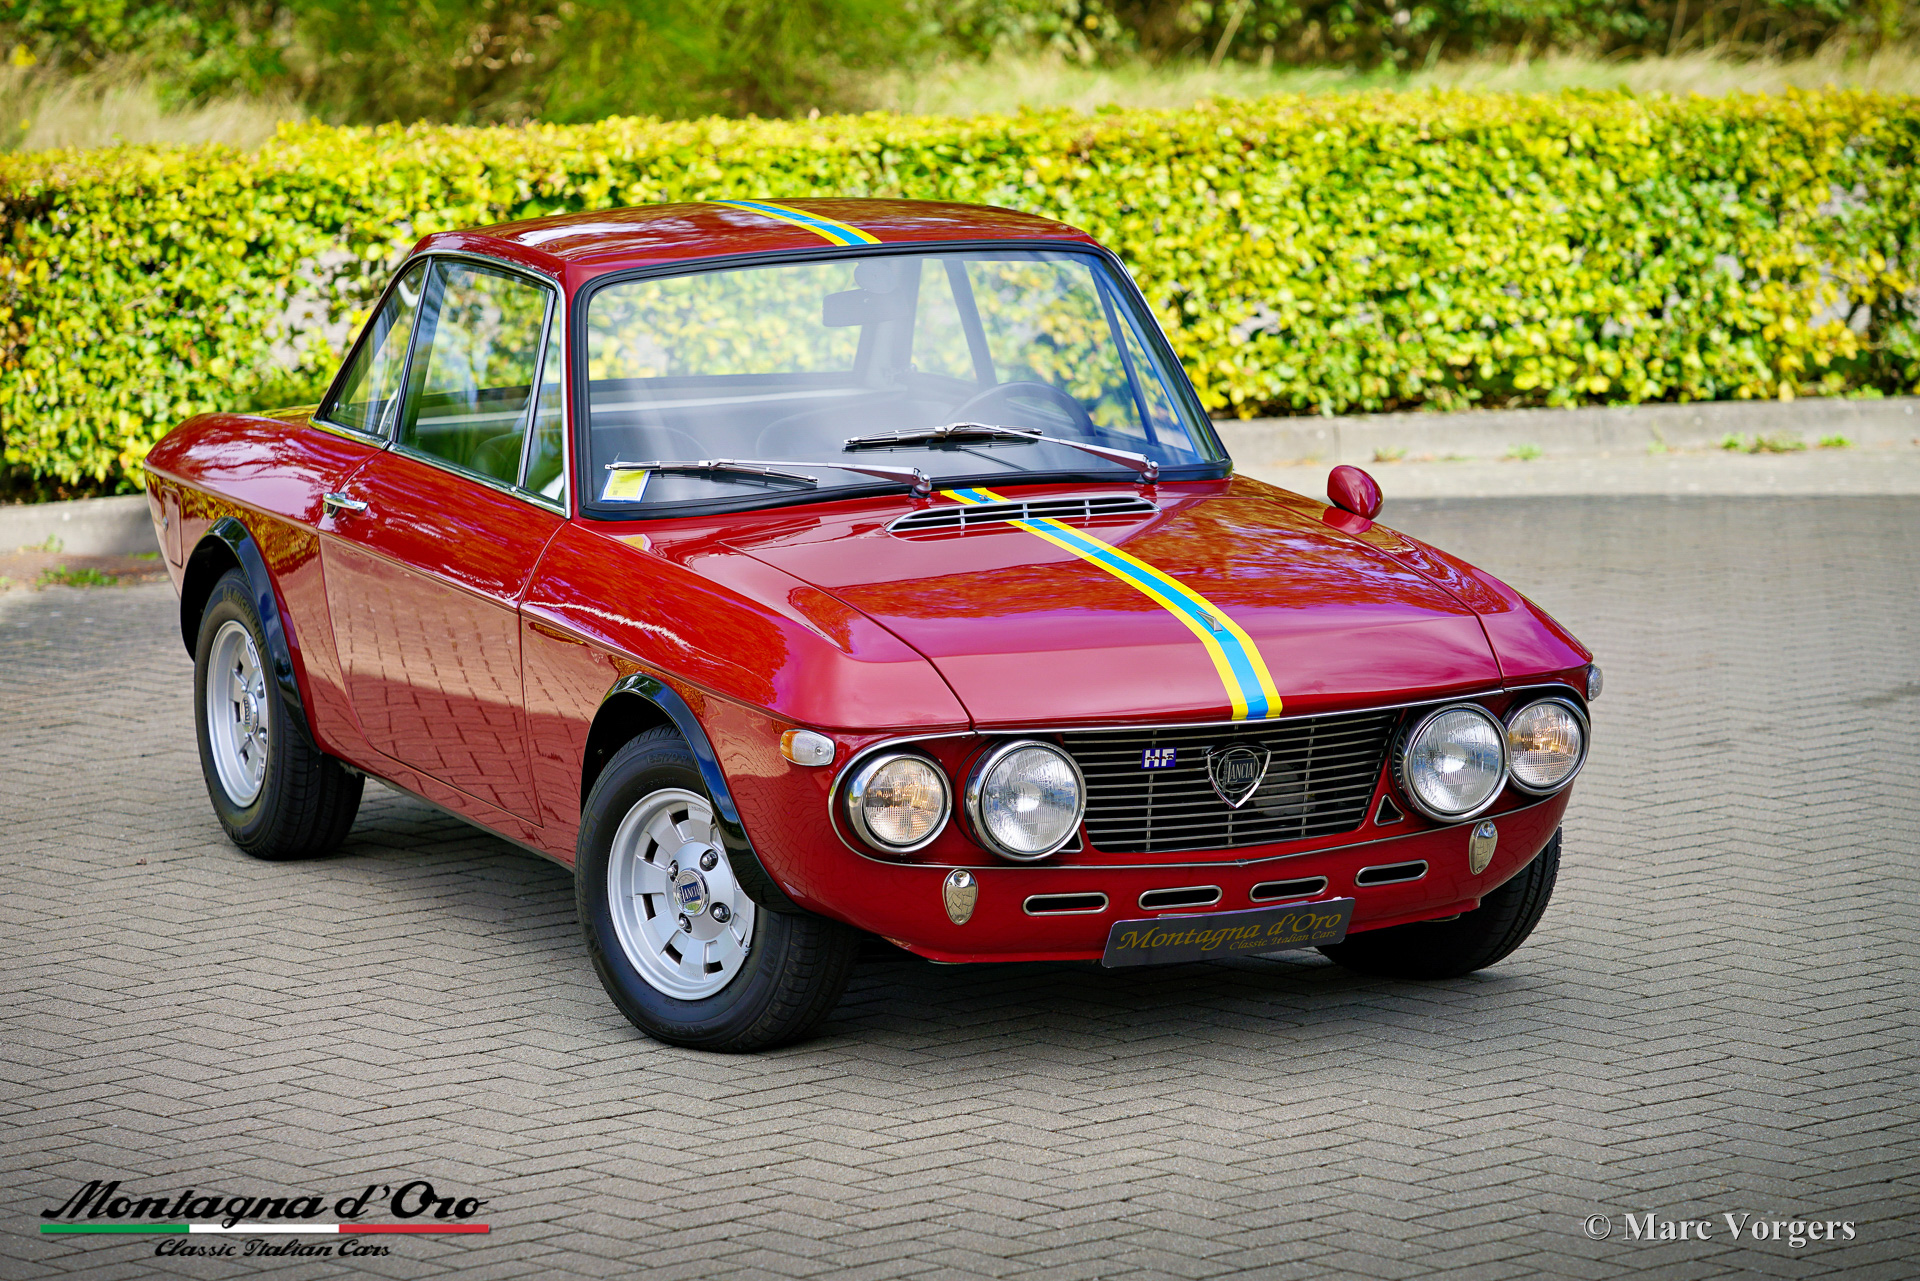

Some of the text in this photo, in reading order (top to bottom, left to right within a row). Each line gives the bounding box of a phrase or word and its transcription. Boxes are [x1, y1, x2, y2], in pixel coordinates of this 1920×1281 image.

[1144, 748, 1175, 768] HF
[1227, 761, 1254, 783] LANCIA
[1116, 913, 1342, 951] Montagna d'Oro
[1229, 930, 1336, 951] Classic Italian Cars
